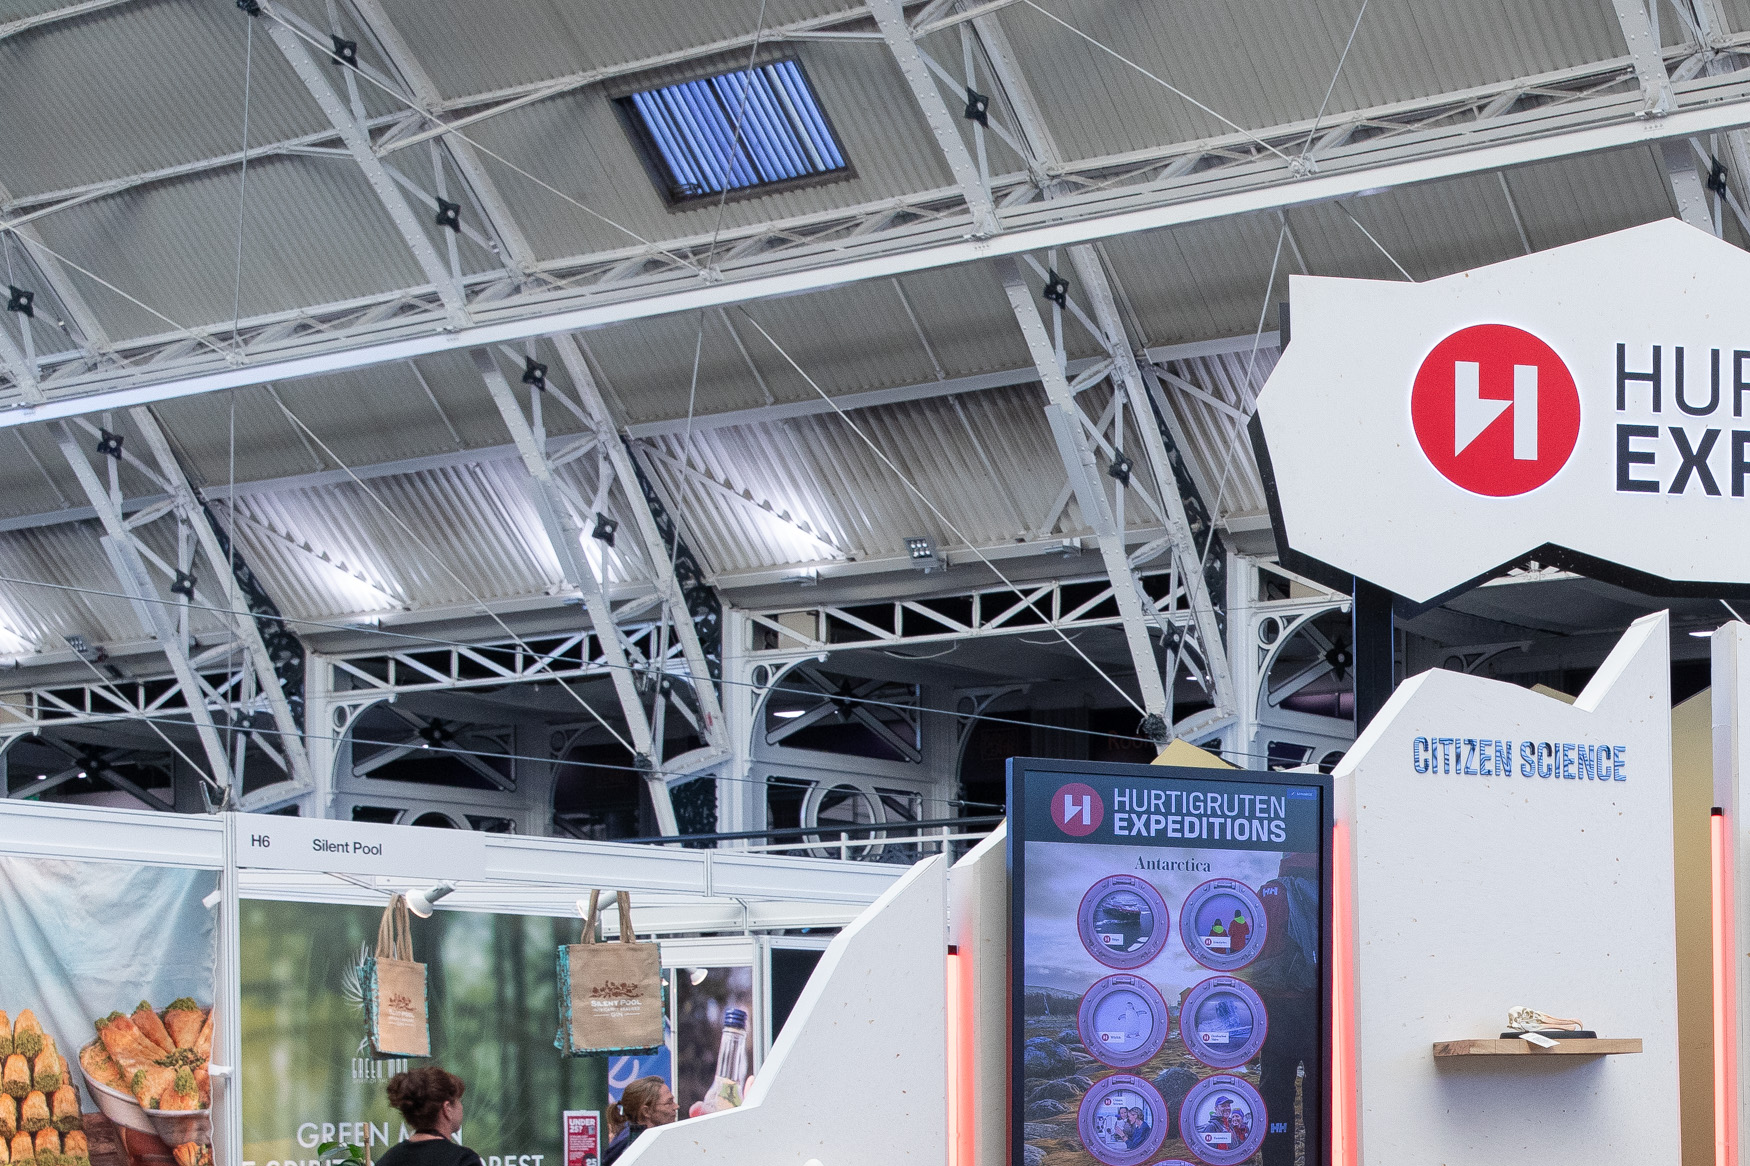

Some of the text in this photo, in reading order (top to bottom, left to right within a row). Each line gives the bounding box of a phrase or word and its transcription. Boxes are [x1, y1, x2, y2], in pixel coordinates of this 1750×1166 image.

[1413, 736, 1627, 782] CITIZEN SCIENCE
[1114, 788, 1286, 818] HURTIGRUTEN
[1114, 813, 1286, 842] EXPEDITIONS
[251, 834, 270, 848] H6
[312, 838, 382, 856] Silent Pool
[1135, 856, 1211, 873] Antarctica
[569, 1118, 596, 1127] UNDER
